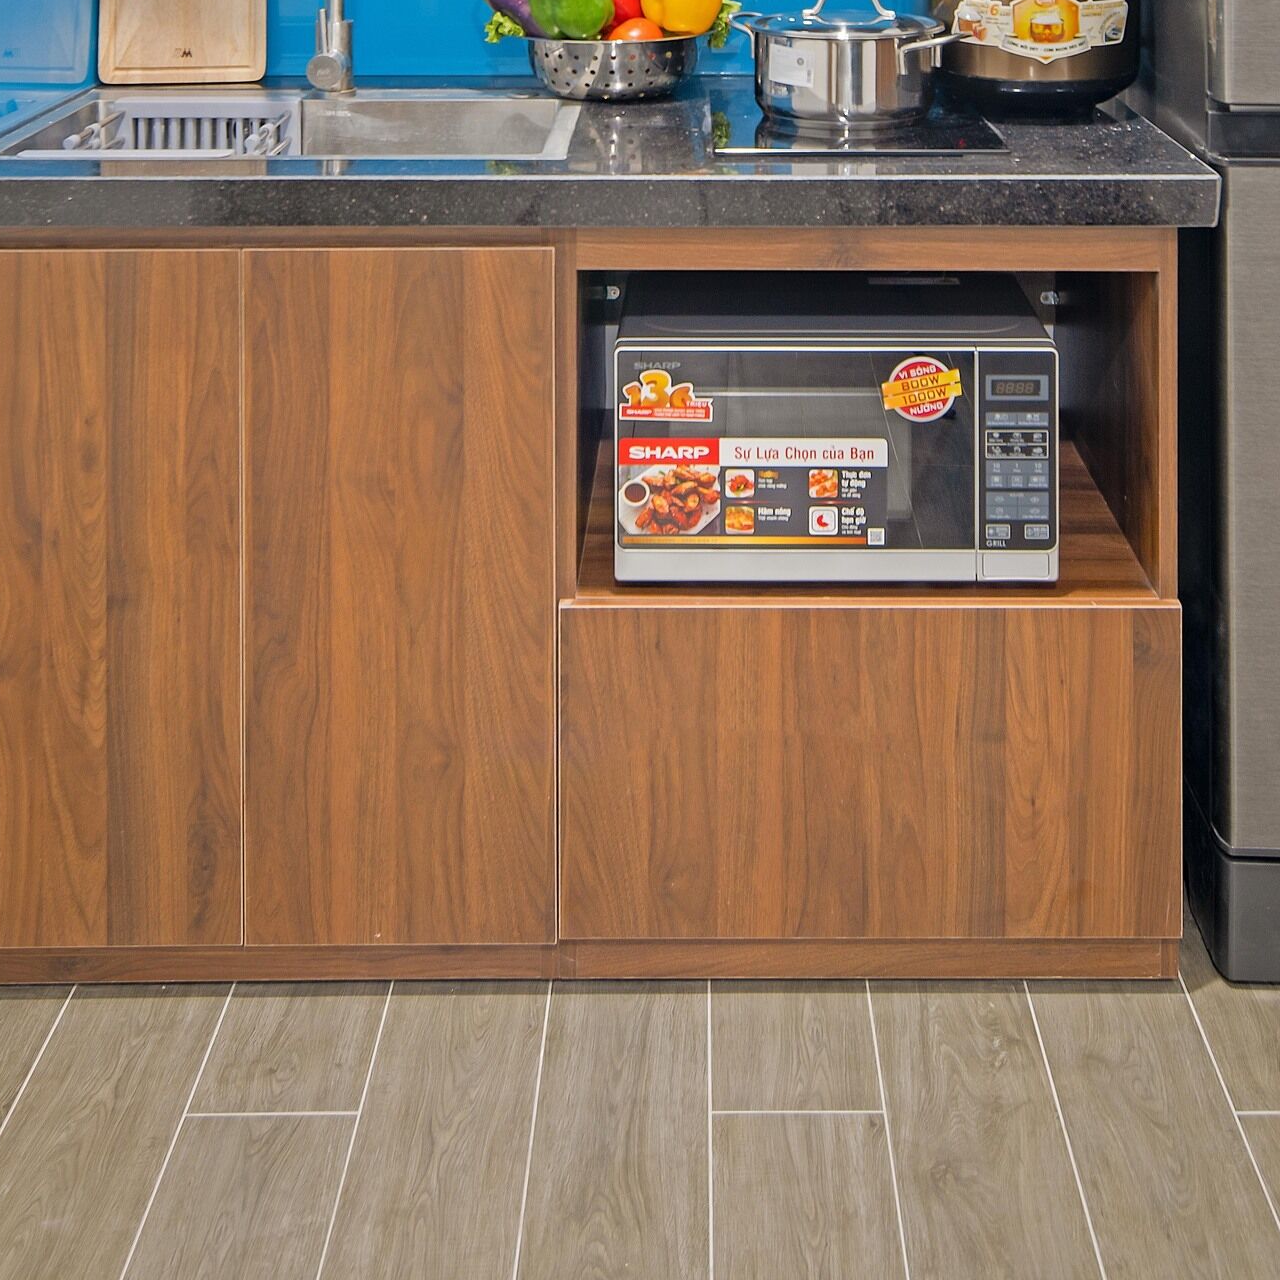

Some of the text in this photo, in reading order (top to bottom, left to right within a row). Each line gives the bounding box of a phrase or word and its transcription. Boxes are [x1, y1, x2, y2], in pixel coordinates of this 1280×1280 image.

[633, 362, 681, 370] SHARP
[909, 364, 937, 378] SÓNG
[901, 374, 940, 392] 800W
[902, 386, 947, 406] 1000W
[629, 446, 710, 459] SHARP
[734, 445, 875, 463] Sự Lựa Chọn của Bạn
